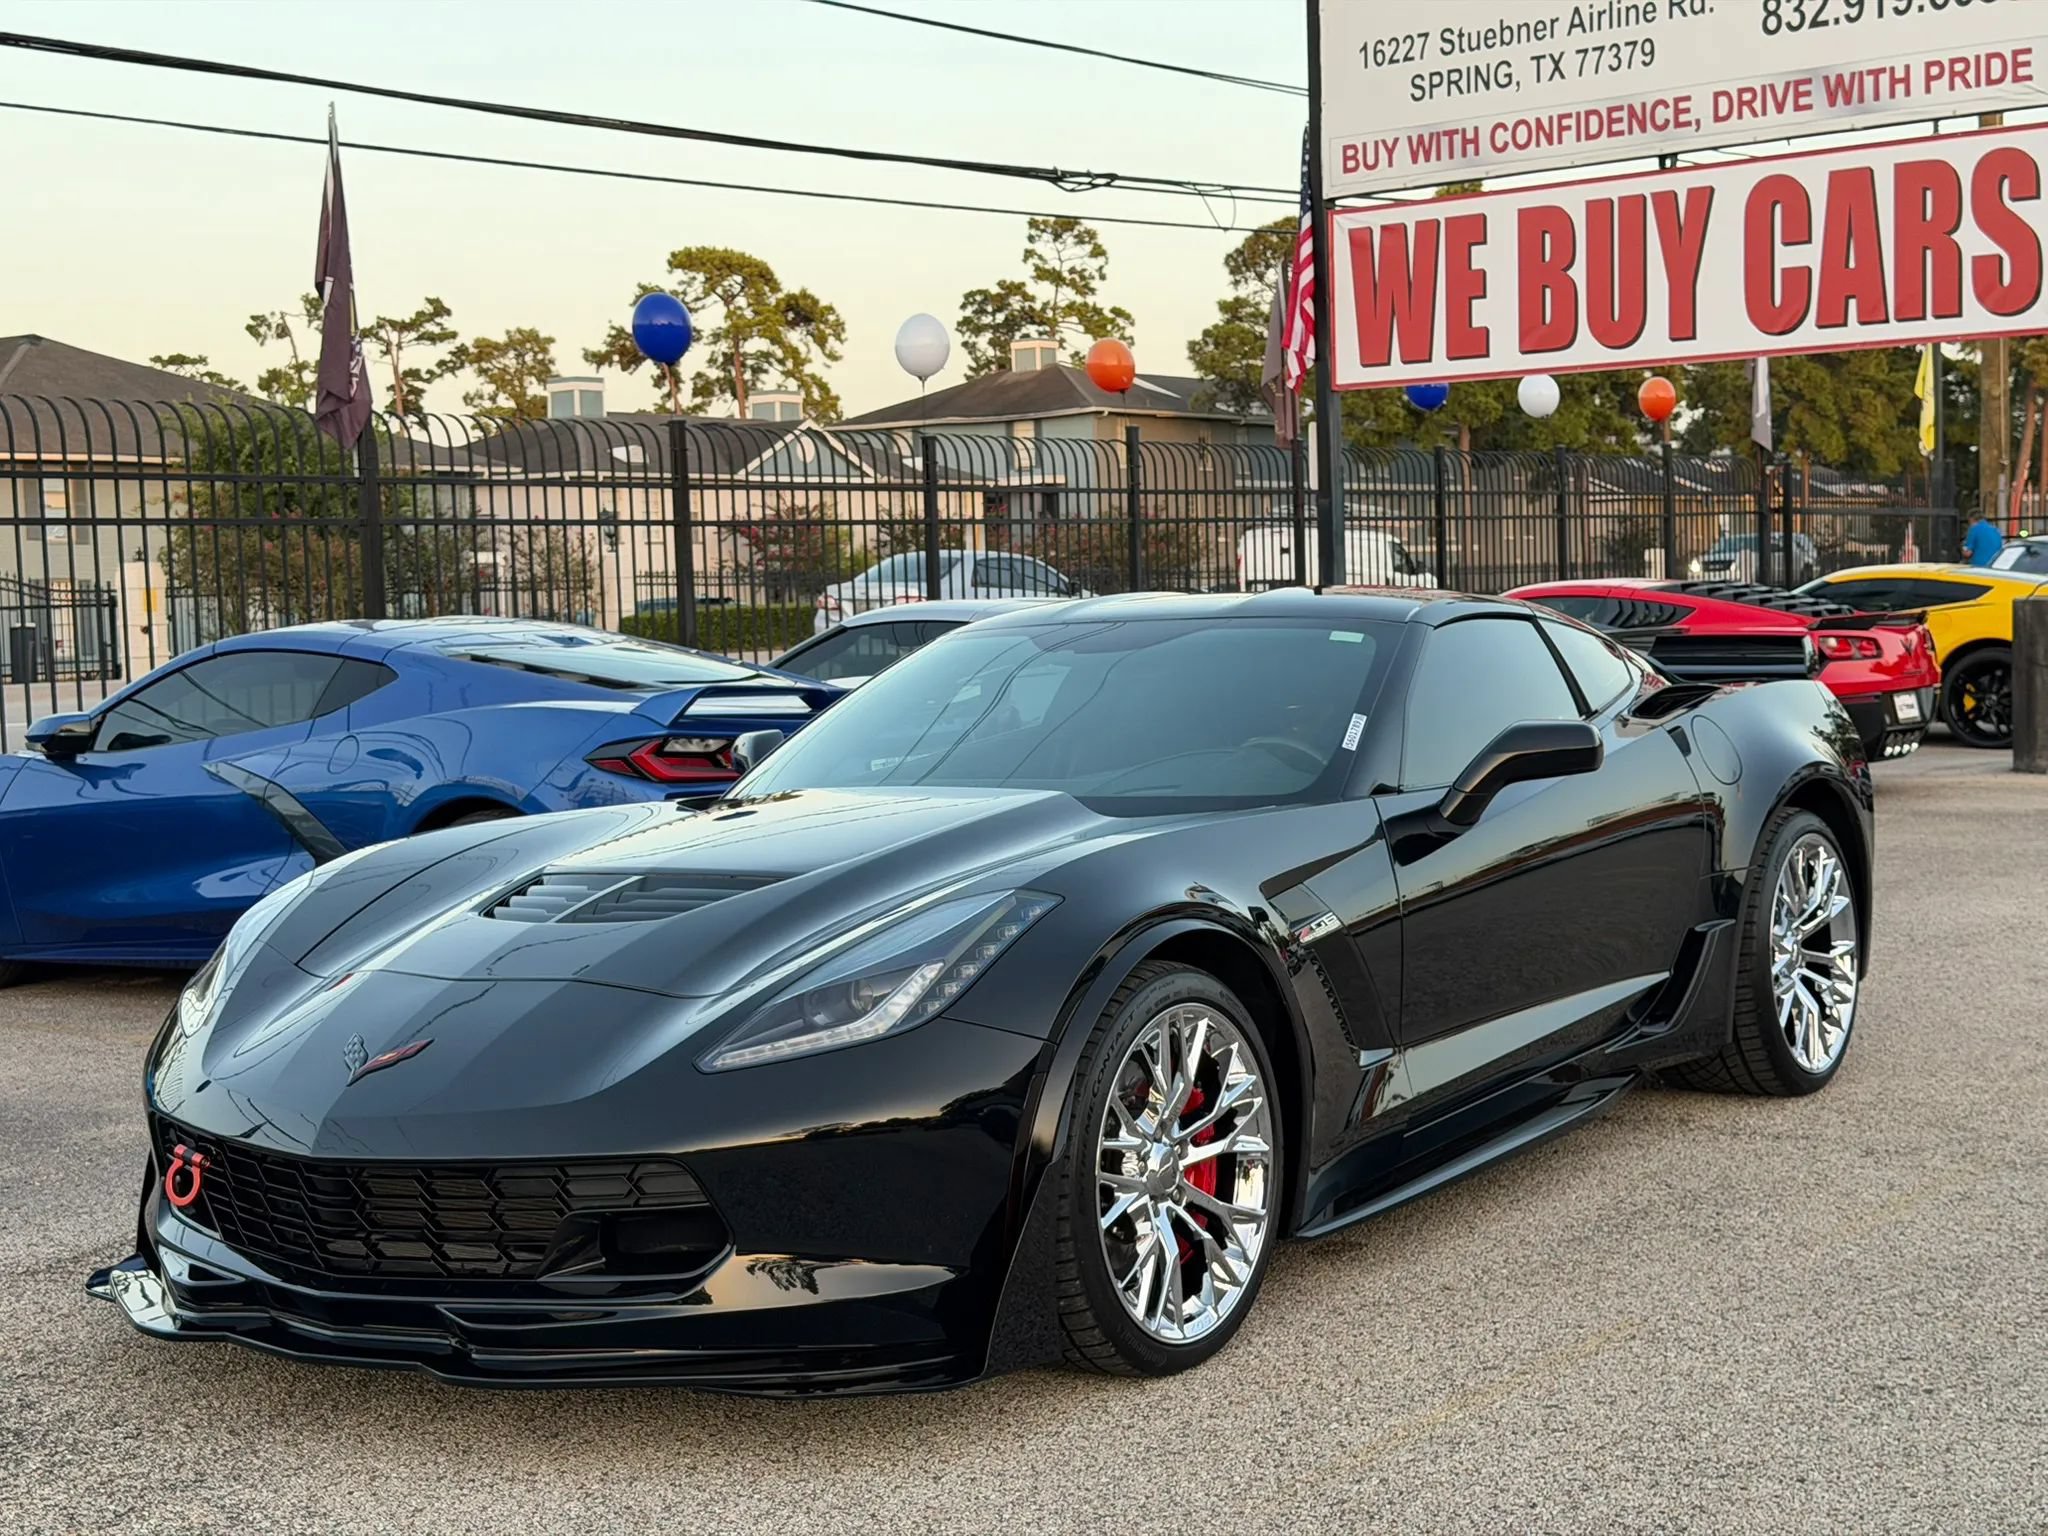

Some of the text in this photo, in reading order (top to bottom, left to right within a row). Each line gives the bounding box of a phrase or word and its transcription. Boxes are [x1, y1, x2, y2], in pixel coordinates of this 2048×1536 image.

[1359, 32, 1430, 69] 16227
[1439, 17, 1560, 57] Stuebner
[1567, 0, 1657, 36] Airline
[1410, 38, 1656, 102] SPRING, TX 77379
[1342, 47, 2033, 174] BUY WITH CONFIDENCE, DRIVE WITH PRIDE
[1347, 147, 2043, 368] WE BUY CARS
